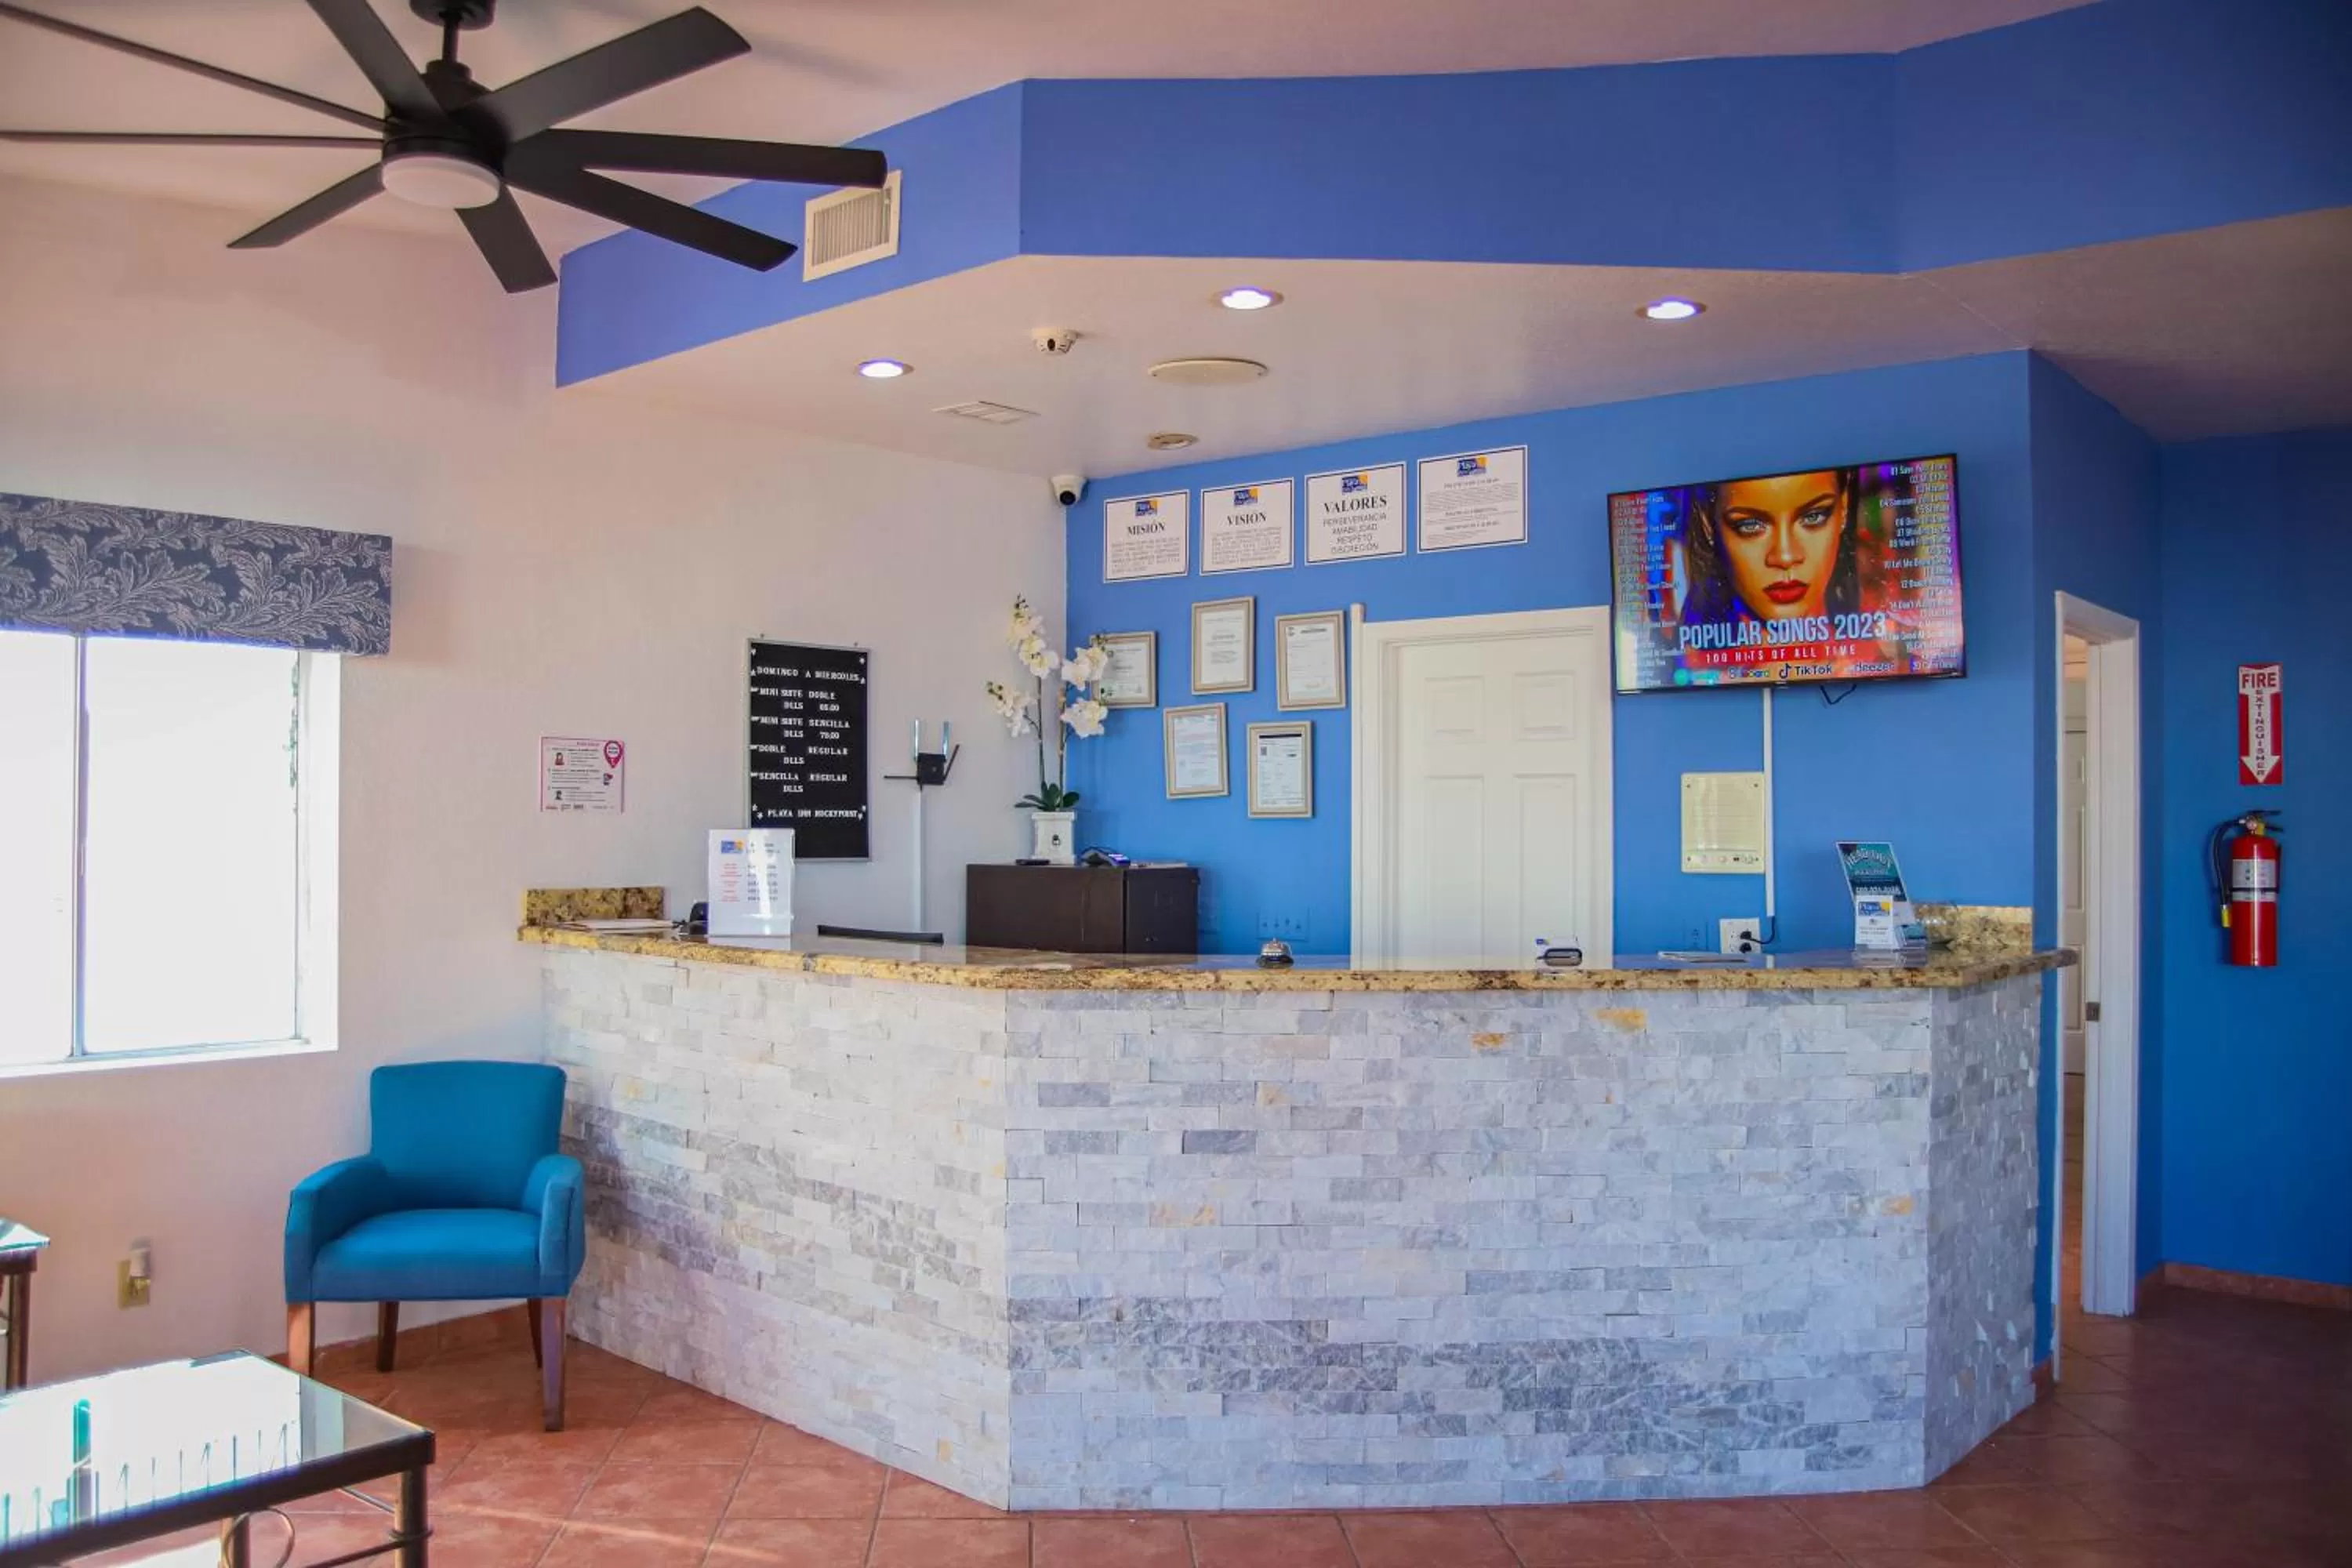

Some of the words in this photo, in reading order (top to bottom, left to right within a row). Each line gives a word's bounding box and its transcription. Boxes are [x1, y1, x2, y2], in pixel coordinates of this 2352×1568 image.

[1323, 495, 1387, 513] VALORES
[1127, 519, 1166, 535] MISIÓN
[1679, 619, 1762, 650] POPULAR
[1767, 615, 1830, 644] SONGS
[1835, 610, 1886, 641] 2023
[1706, 652, 1727, 663] 100
[1735, 649, 1763, 662] HITS
[1771, 648, 1786, 659] OF
[1794, 646, 1817, 658] ALL
[1825, 644, 1857, 656] TIME
[757, 666, 799, 677] DOMINGO
[1795, 662, 1832, 676] TikTok
[2241, 672, 2277, 688] FIRE
[808, 718, 851, 728] SENCILLA
[2255, 689, 2265, 775] EXTINGUISHER
[808, 746, 848, 756] REGULAR
[783, 756, 804, 765] DLLS
[758, 771, 799, 781] SENCILLA
[809, 773, 848, 782] REGULAR
[767, 808, 793, 818] PLAYA
